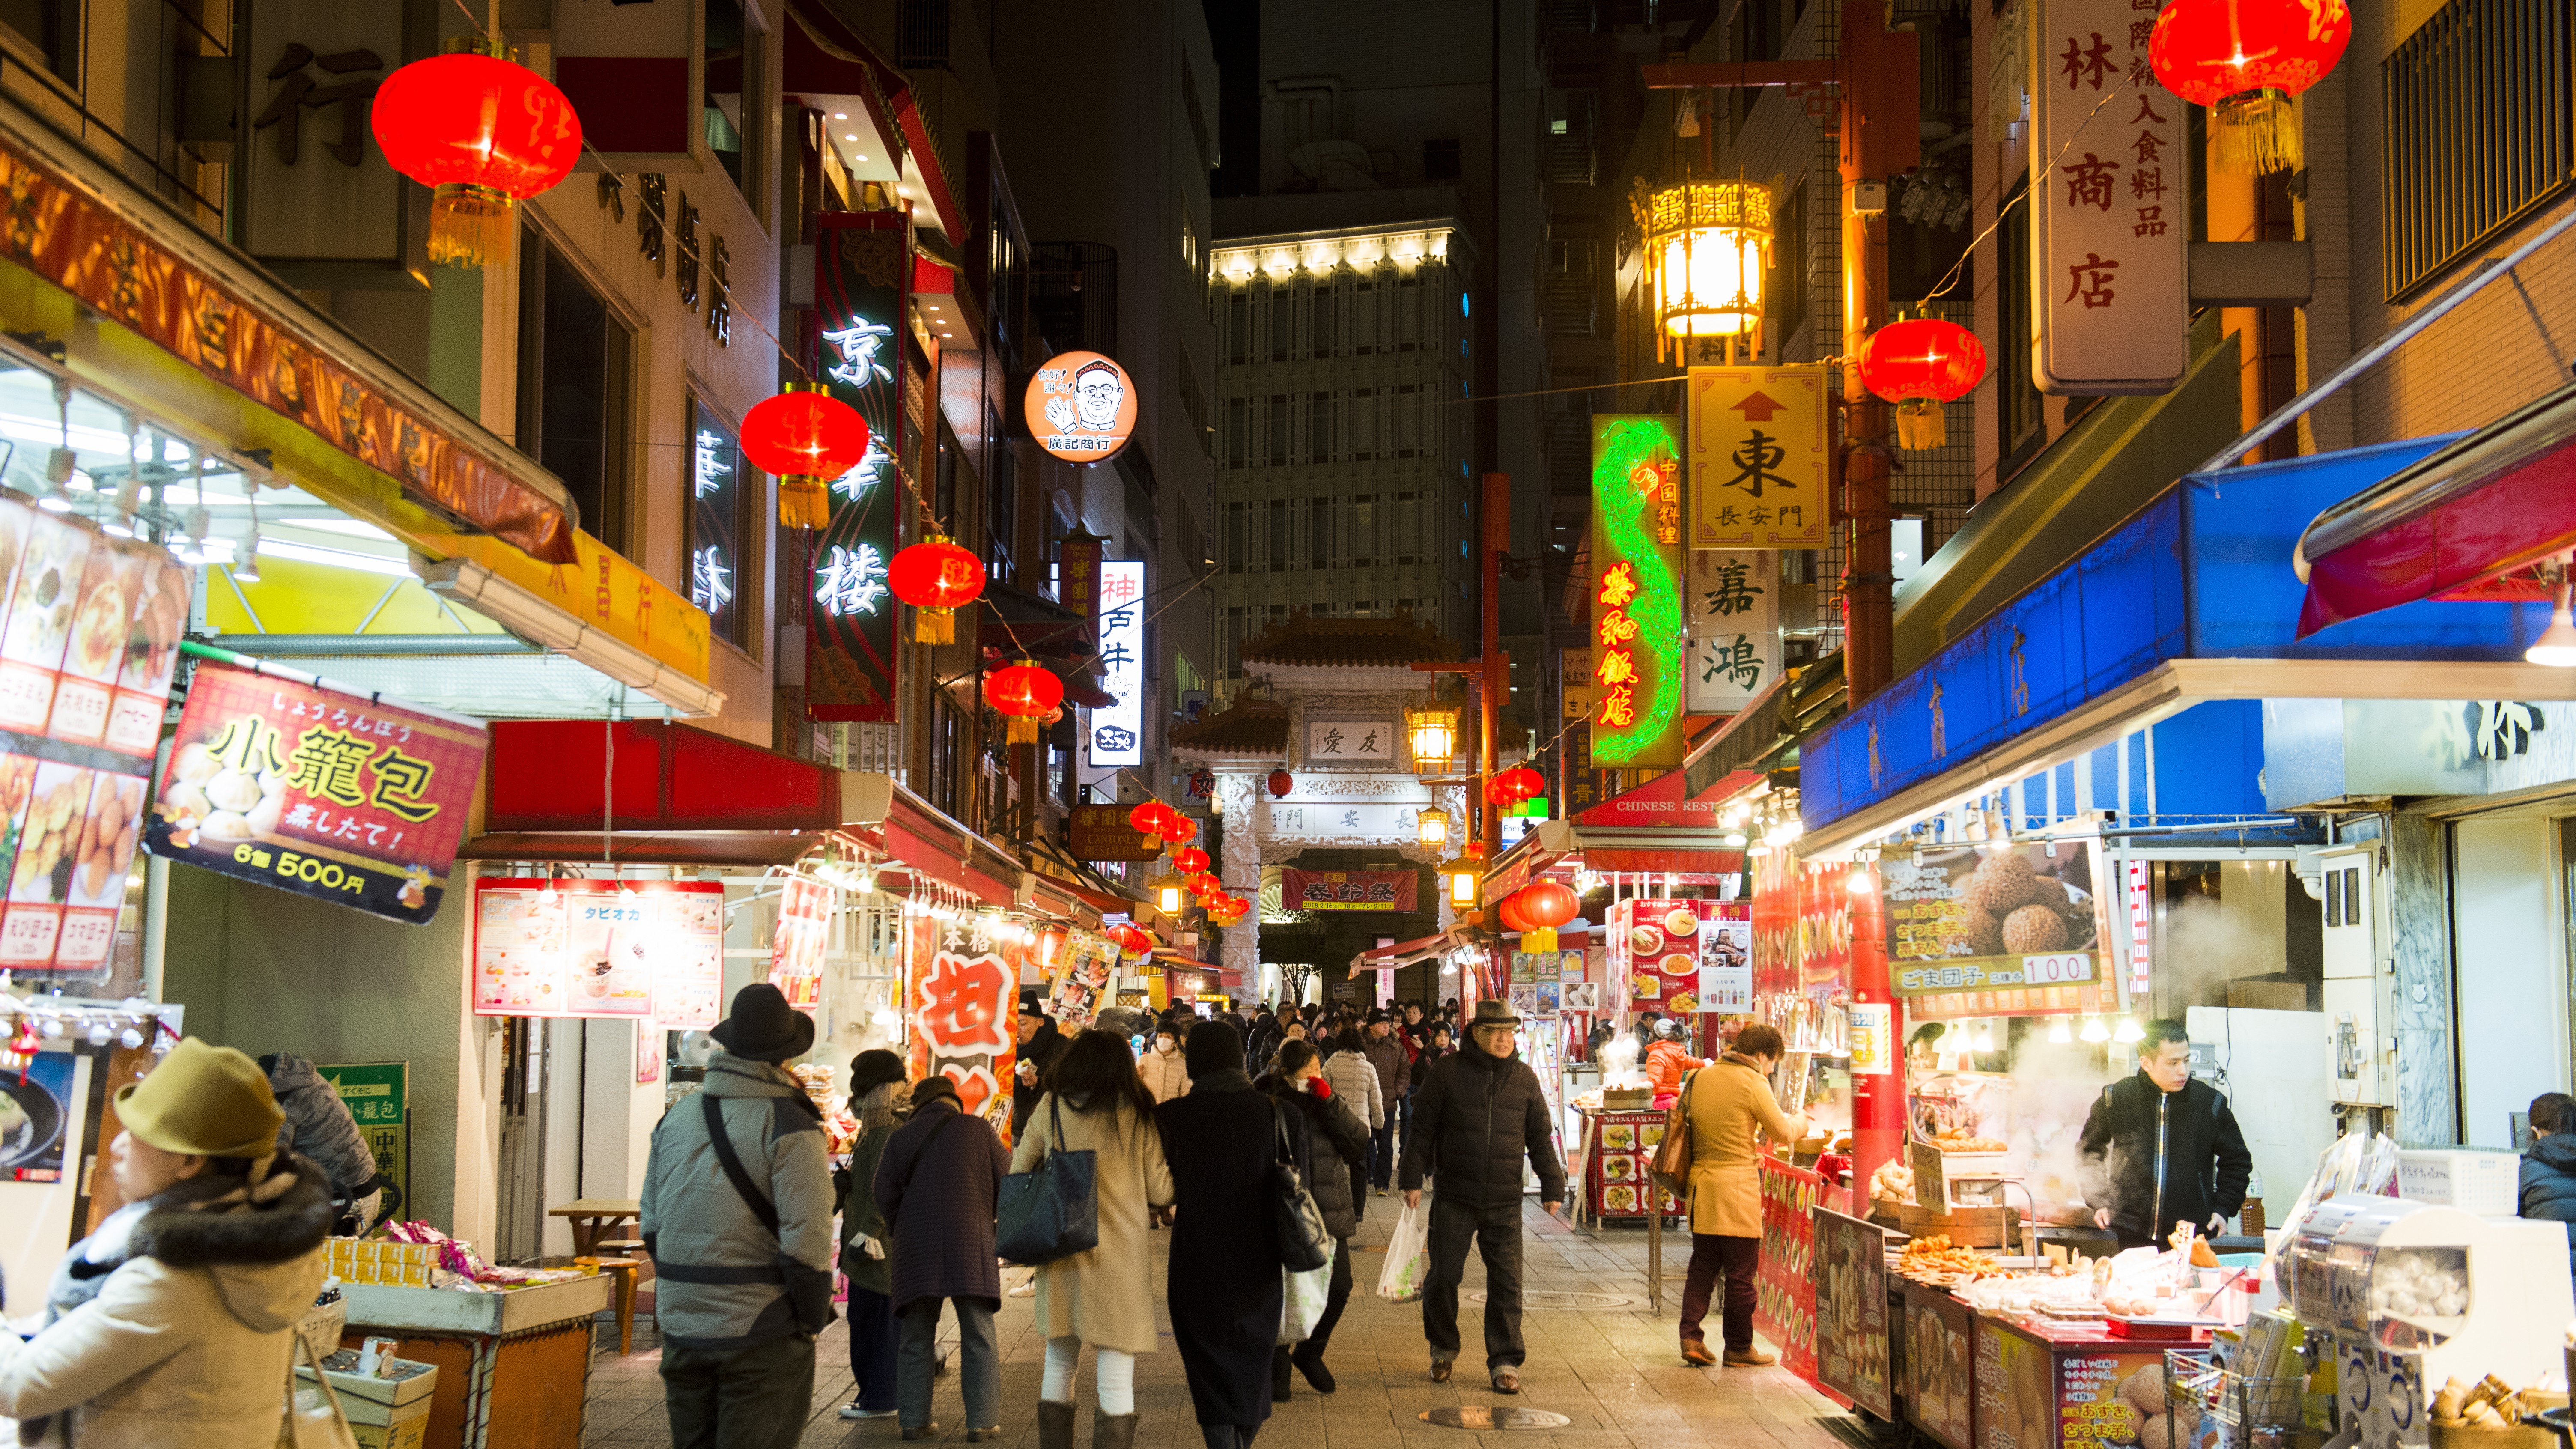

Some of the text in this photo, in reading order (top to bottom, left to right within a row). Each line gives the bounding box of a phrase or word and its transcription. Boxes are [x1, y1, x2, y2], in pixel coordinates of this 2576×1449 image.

[2060, 32, 2120, 309] 林商店
[1048, 435, 1111, 450] 廣記商行
[1721, 429, 1798, 498] 東
[1656, 459, 1680, 545] 中国料理
[1715, 505, 1802, 528] 長安門
[1100, 573, 1136, 674] 神戸牛
[1702, 558, 1765, 692] 嘉鴻
[273, 692, 412, 743] しょうろんぼう
[206, 714, 441, 823] 小籠包
[1577, 733, 1589, 778] 広東菜館
[1616, 801, 1675, 812] CHINESE
[1303, 881, 1396, 902] 春節祭
[942, 925, 993, 953] 本格
[1902, 965, 1983, 987] ごま団子
